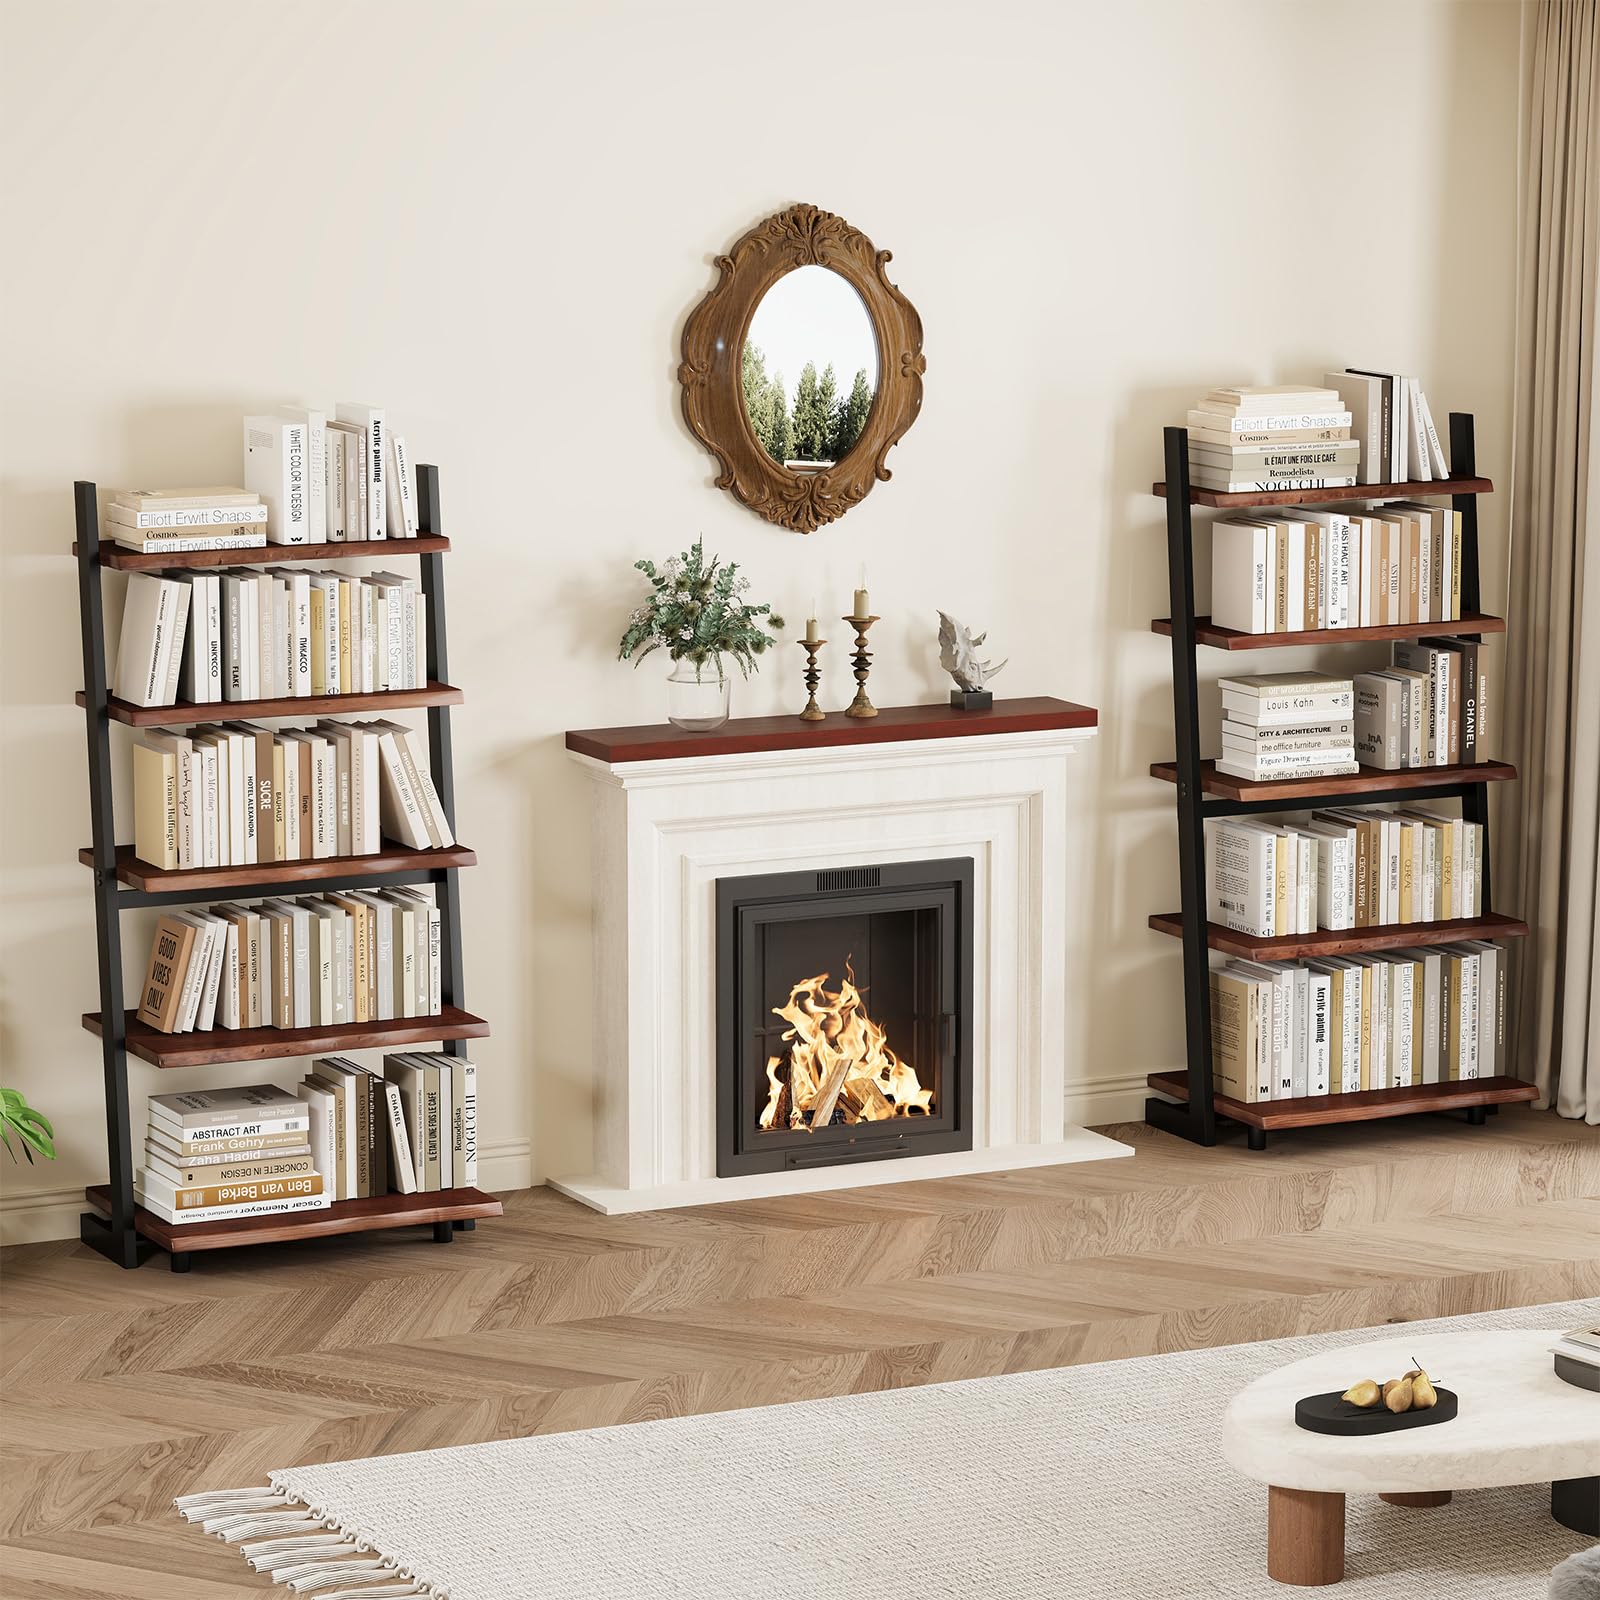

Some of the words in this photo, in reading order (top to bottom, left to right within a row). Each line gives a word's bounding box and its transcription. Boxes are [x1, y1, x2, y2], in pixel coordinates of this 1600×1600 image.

[1234, 419, 1263, 431] Elliott
[1267, 417, 1298, 429] Erwitt
[1301, 415, 1337, 428] Snaps
[290, 428, 301, 453] WHITE
[373, 419, 381, 447] Acrylic
[1239, 434, 1269, 442] Cosmos
[373, 449, 381, 483] painting
[1264, 457, 1270, 466] IL
[1271, 455, 1287, 465] ÉTAIT
[1288, 455, 1299, 464] UNE
[1300, 455, 1313, 463] FOIS
[1314, 454, 1321, 463] LE
[1322, 453, 1336, 462] CAFÉ
[291, 456, 302, 482] COLOR
[1269, 468, 1315, 478] Remodelista
[291, 483, 301, 492] IN
[1255, 478, 1325, 492] NOGUCHI
[291, 493, 302, 523] DESIGN
[140, 511, 172, 527] Elliott
[176, 510, 209, 525] Erwitt
[213, 510, 252, 523] Snaps
[146, 530, 178, 540] Cosmos
[1341, 524, 1349, 566] ABSTRACT
[1331, 576, 1339, 605] DESIGN
[389, 589, 400, 614] Elliott
[390, 617, 401, 645] Erwitt
[300, 638, 308, 673] ПИКАССО
[390, 647, 401, 679] Snaps
[1440, 657, 1449, 681] Figure
[1266, 700, 1289, 710] Louis
[1293, 698, 1314, 708] Kahn
[1259, 730, 1274, 738] CITY
[1282, 726, 1332, 736] ARCHITECTURE
[1467, 699, 1475, 749] CHANEL
[1261, 744, 1272, 752] the
[1274, 742, 1292, 751] office
[1294, 740, 1321, 749] furniture
[1260, 757, 1282, 766] Figure
[1283, 755, 1311, 764] Drawing
[1260, 773, 1272, 781] the
[1295, 768, 1324, 777] furniture
[260, 780, 271, 810] SUCRE
[167, 807, 175, 851] Huffington
[1335, 840, 1346, 862] Elliott
[1334, 864, 1346, 888] Erwitt
[1334, 890, 1345, 919] Snaps
[431, 921, 440, 938] Renzo
[1228, 921, 1257, 935] PHAIDON
[158, 936, 177, 960] GOOD
[431, 939, 440, 957] Piano
[297, 948, 307, 969] Dior
[152, 961, 171, 986] VIBES
[1403, 966, 1412, 995] Elliott
[147, 987, 164, 1010] ONLY
[1316, 987, 1326, 1012] Acrylic
[1402, 1000, 1411, 1031] Erwitt
[1315, 1013, 1325, 1043] painting
[1402, 1035, 1411, 1071] Snaps
[1282, 1079, 1291, 1088] M
[428, 1091, 436, 1106] CAFÉ
[391, 1093, 400, 1127] CHANEL
[429, 1114, 437, 1126] FOIS
[466, 1094, 477, 1163] NOGUCHI
[192, 1127, 241, 1140] ABSTRACT
[243, 1125, 261, 1135] ART
[429, 1127, 437, 1138] UNE
[190, 1141, 225, 1153] Frank
[228, 1137, 265, 1151] Gehry
[428, 1138, 437, 1154] ÉTAIT
[188, 1156, 221, 1167] Zaha
[223, 1150, 261, 1161] Hadid
[220, 1168, 251, 1179] DESIGN
[253, 1166, 262, 1175] IN
[263, 1162, 309, 1175] CONCRETE
[218, 1185, 258, 1202] Berkel
[262, 1183, 285, 1194] van
[287, 1180, 312, 1193] Ben
[240, 1203, 289, 1214] Niemeyer
[291, 1200, 322, 1208] Oscar
